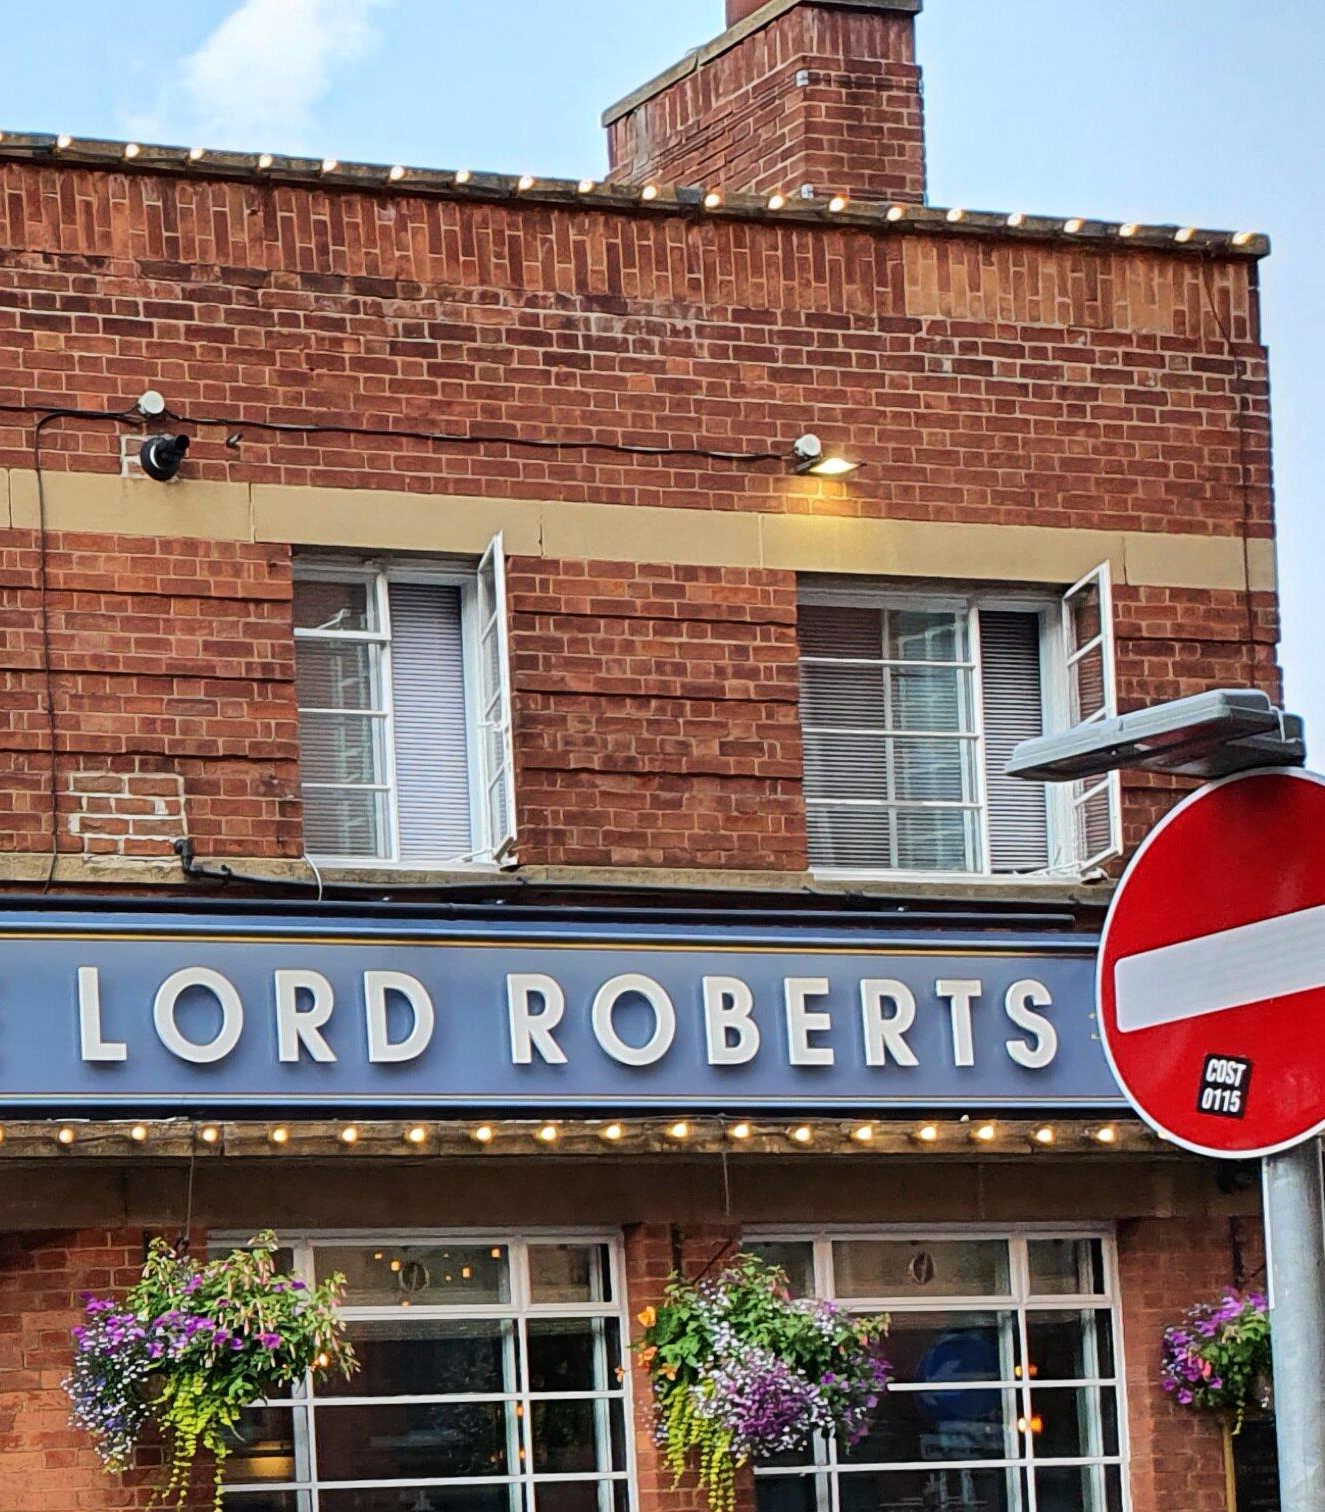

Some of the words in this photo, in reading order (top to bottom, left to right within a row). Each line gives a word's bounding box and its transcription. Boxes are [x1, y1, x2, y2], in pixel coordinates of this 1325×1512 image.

[78, 966, 434, 1066] LORD
[506, 971, 1059, 1070] ROBERTS
[1205, 1058, 1247, 1087] COST
